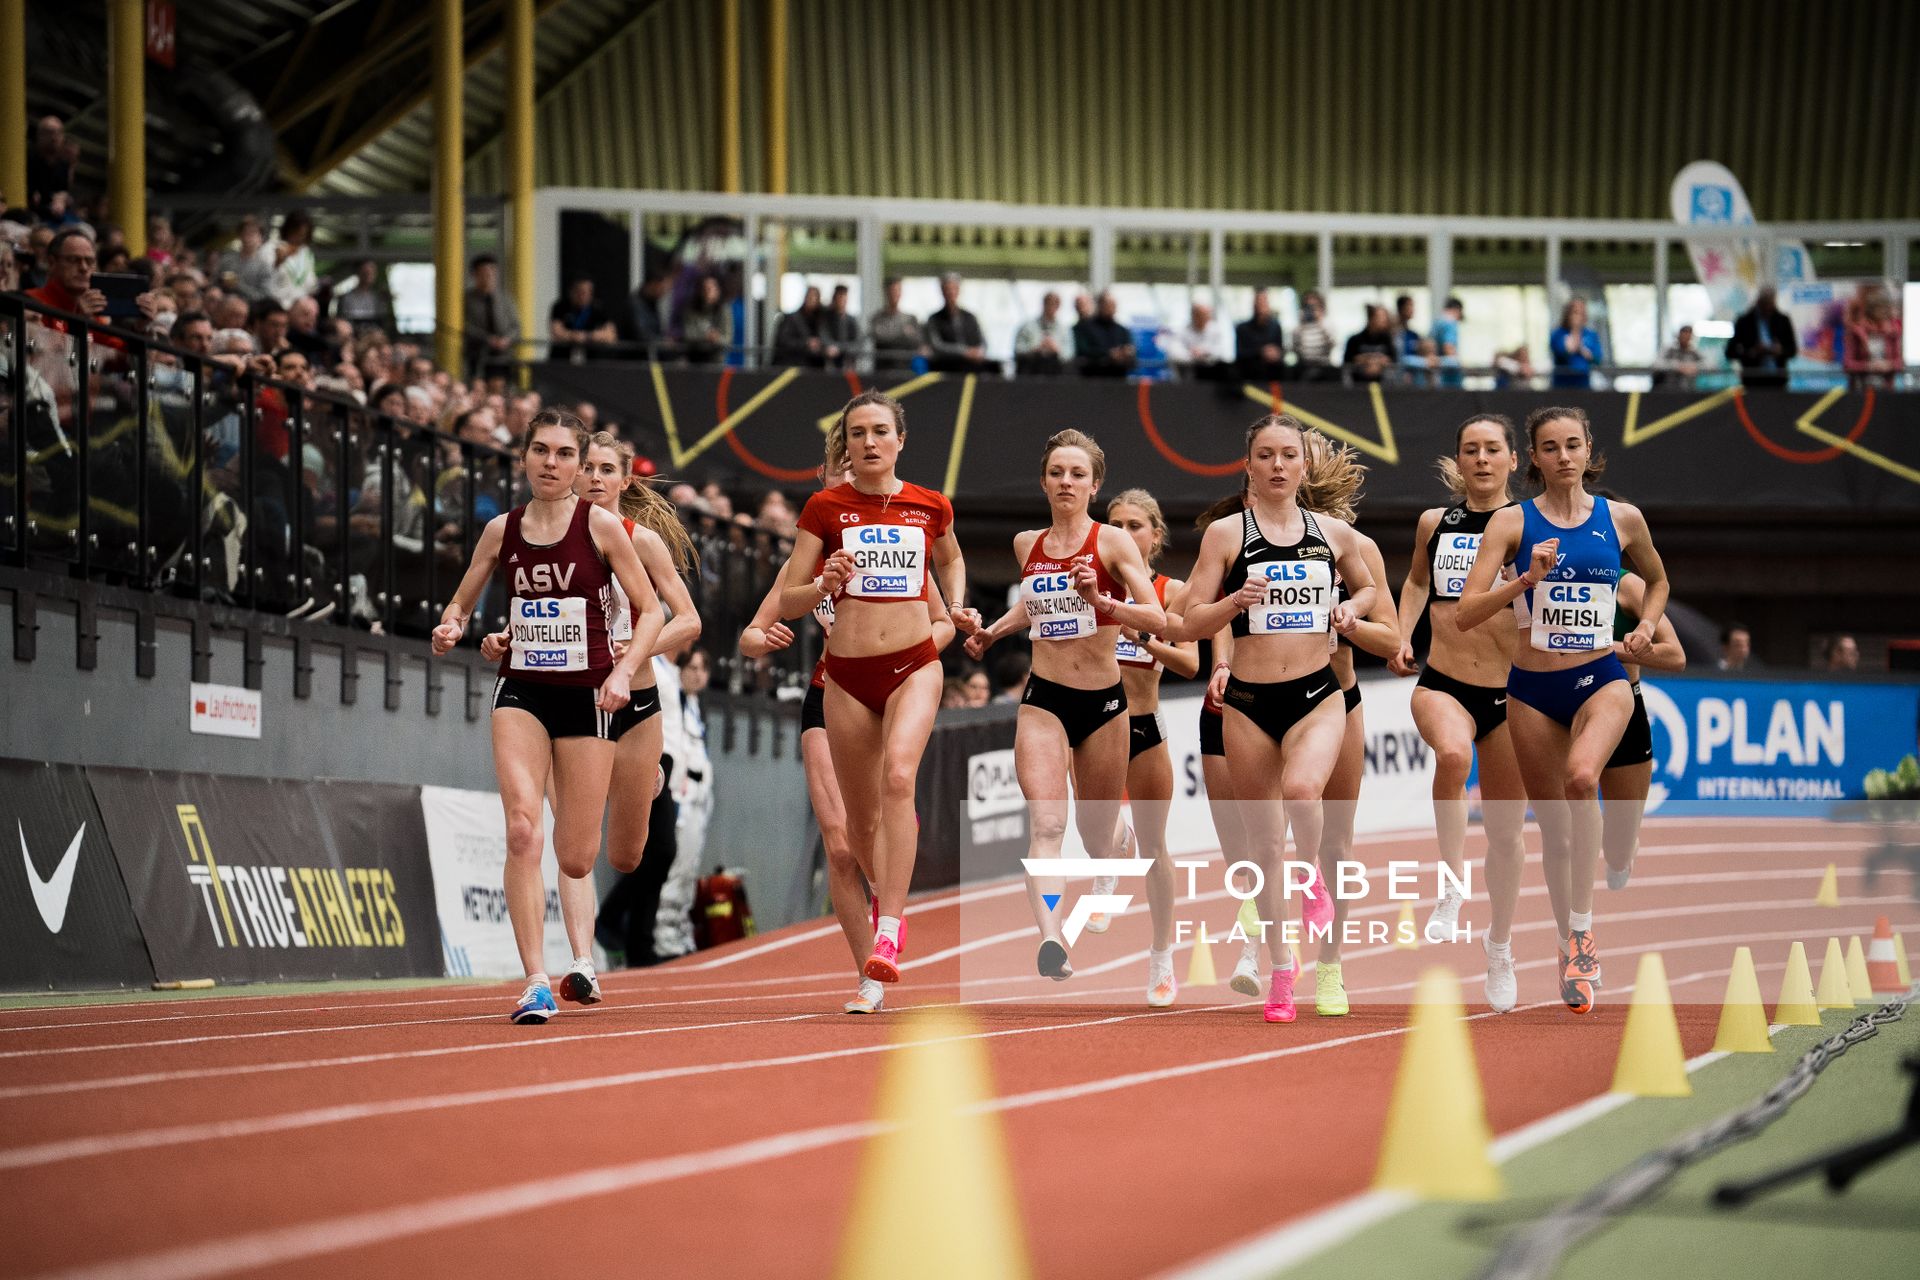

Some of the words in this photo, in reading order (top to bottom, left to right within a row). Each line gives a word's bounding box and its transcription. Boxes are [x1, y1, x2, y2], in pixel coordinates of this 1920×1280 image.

[840, 513, 860, 523] CG
[910, 510, 931, 520] NORD
[1452, 536, 1483, 550] GL
[854, 550, 917, 569] GRANZ
[1035, 562, 1062, 571] Brillux
[514, 562, 576, 595] ASV
[881, 578, 906, 587] PLAN
[1286, 615, 1312, 624] PLAN
[1542, 608, 1604, 628] MEISL
[1052, 622, 1077, 632] PLAN
[1567, 636, 1593, 645] PLAN
[539, 652, 566, 661] PLAN
[1697, 698, 1845, 767] PLAN
[1697, 776, 1845, 800] INTERNATIONAL
